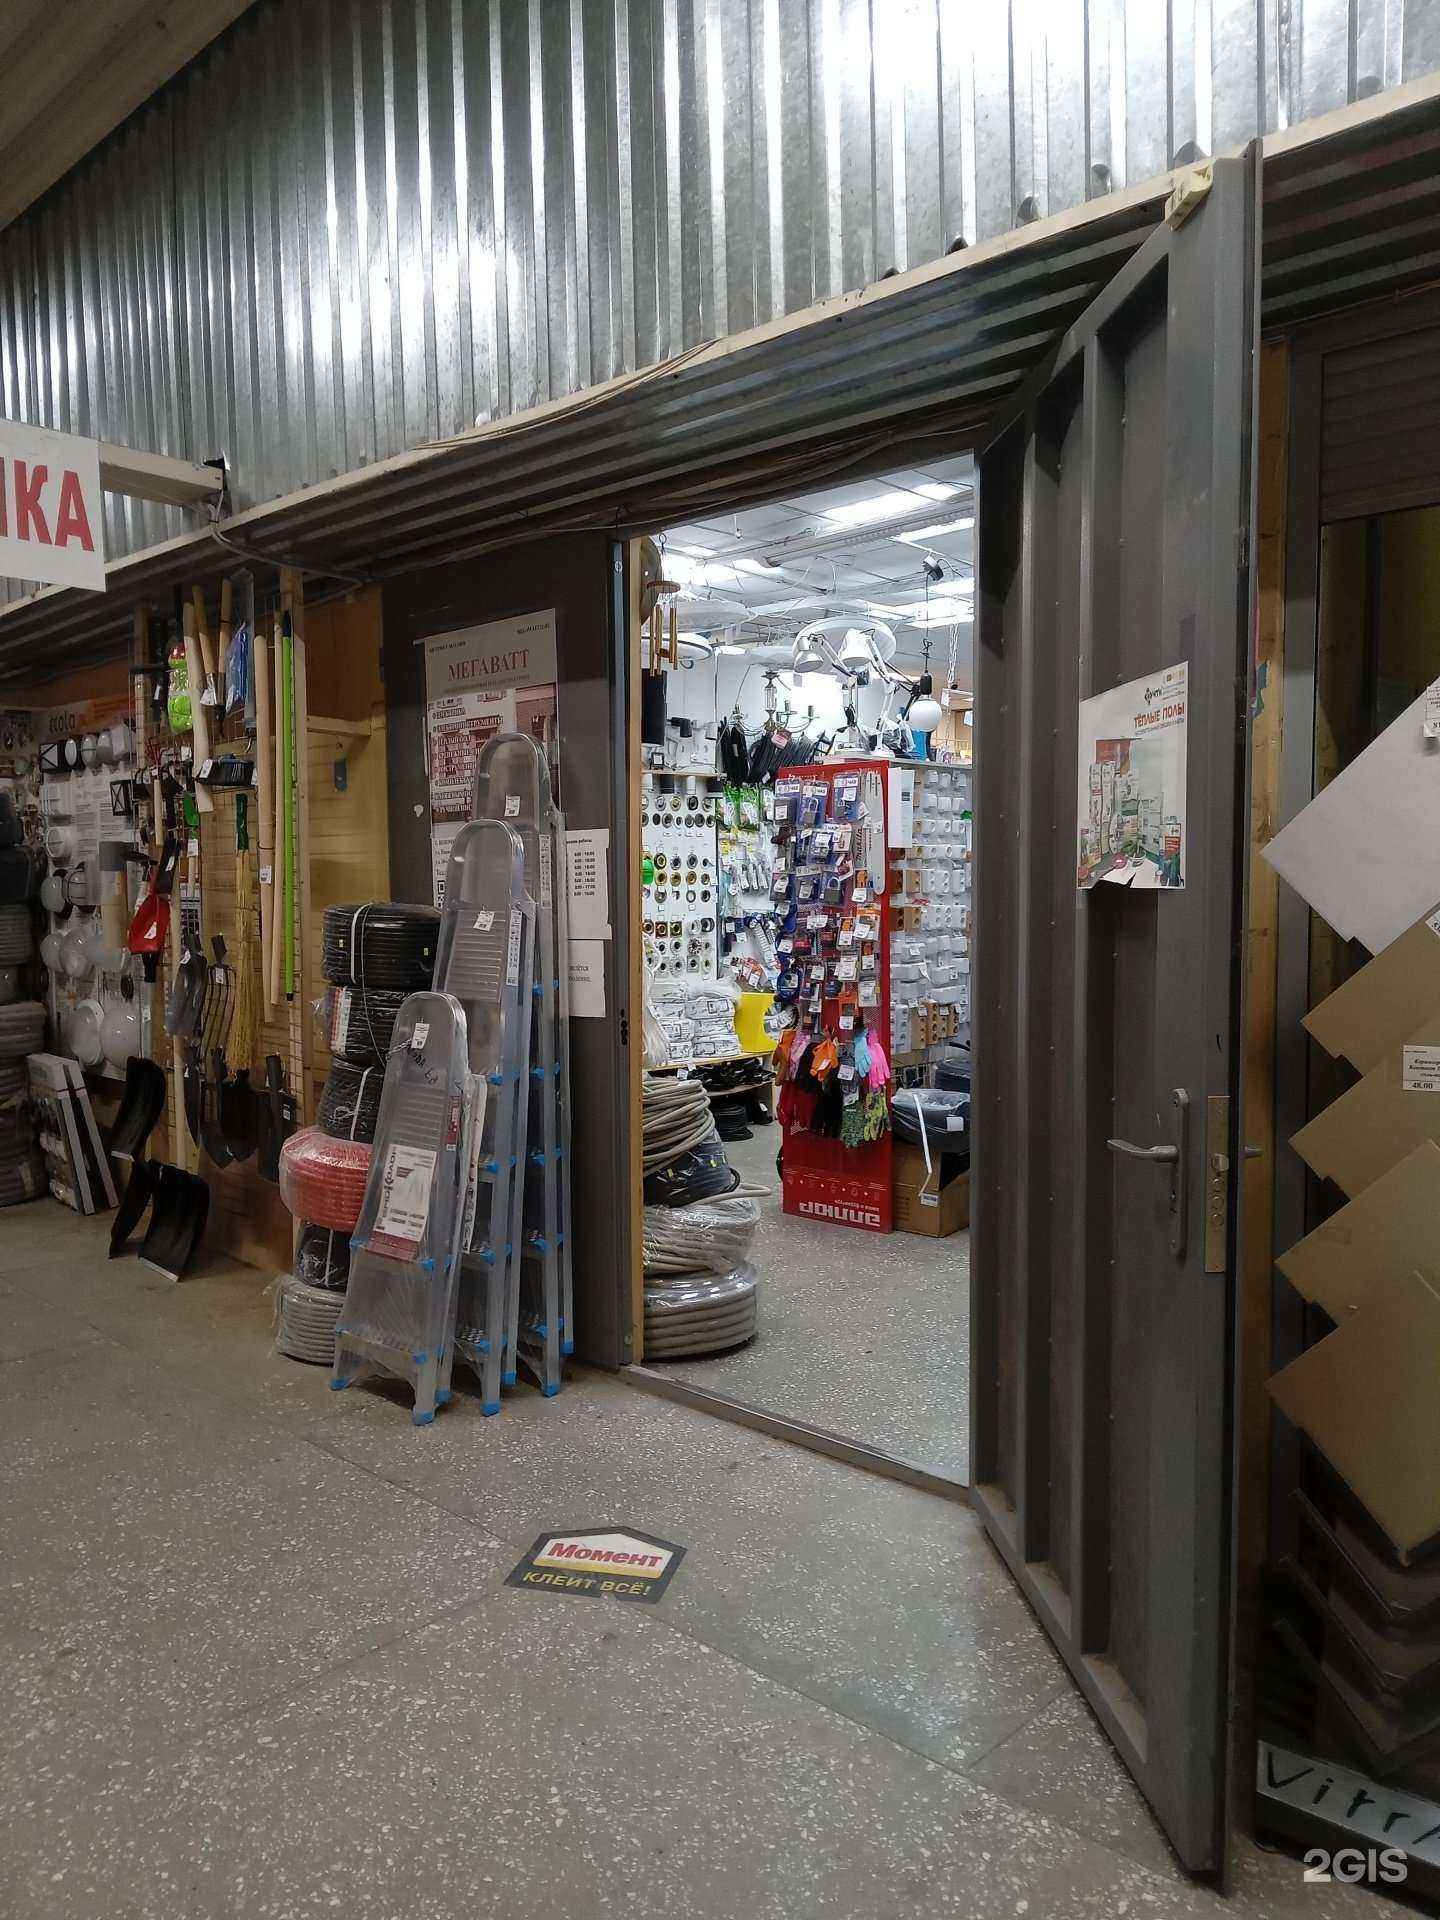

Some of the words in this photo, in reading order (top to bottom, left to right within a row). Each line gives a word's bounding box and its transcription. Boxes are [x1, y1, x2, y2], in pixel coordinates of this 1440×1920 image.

[447, 649, 529, 681] МЕГАВАТТ
[1134, 710, 1161, 728] ТЁПЛЫЕ
[1162, 702, 1185, 720] ПОЛЫ
[548, 1542, 663, 1568] Момент
[522, 1571, 598, 1589] КЛЕИТ
[600, 1580, 652, 1596] ВСЁ!
